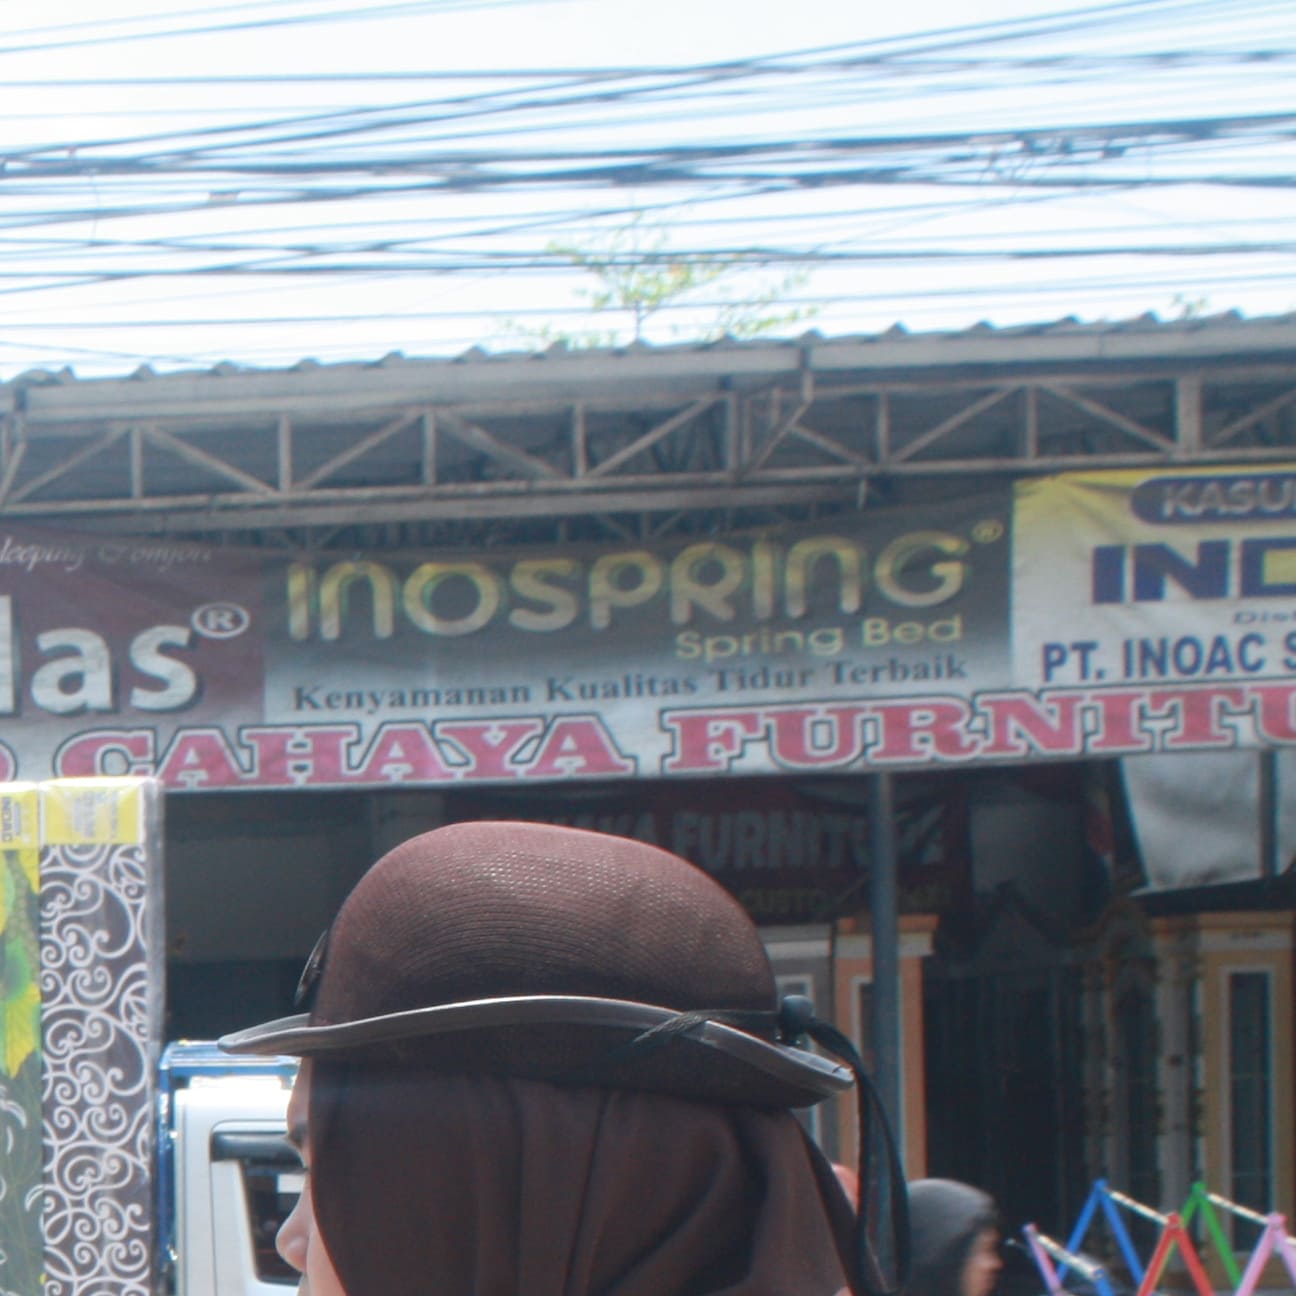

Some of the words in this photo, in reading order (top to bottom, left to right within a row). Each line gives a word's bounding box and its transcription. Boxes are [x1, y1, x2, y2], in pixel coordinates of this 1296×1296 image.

[1162, 476, 1296, 520] KASU
[676, 625, 843, 665] Spring
[861, 615, 963, 647] Bed
[1042, 640, 1105, 683] PT.
[1123, 632, 1266, 679] INOAC
[293, 683, 531, 714] Kenyamanan
[545, 673, 698, 705] Kualitas
[716, 665, 809, 693] Tidur
[825, 655, 969, 686] Terbaik
[54, 711, 637, 793] CAHAYA
